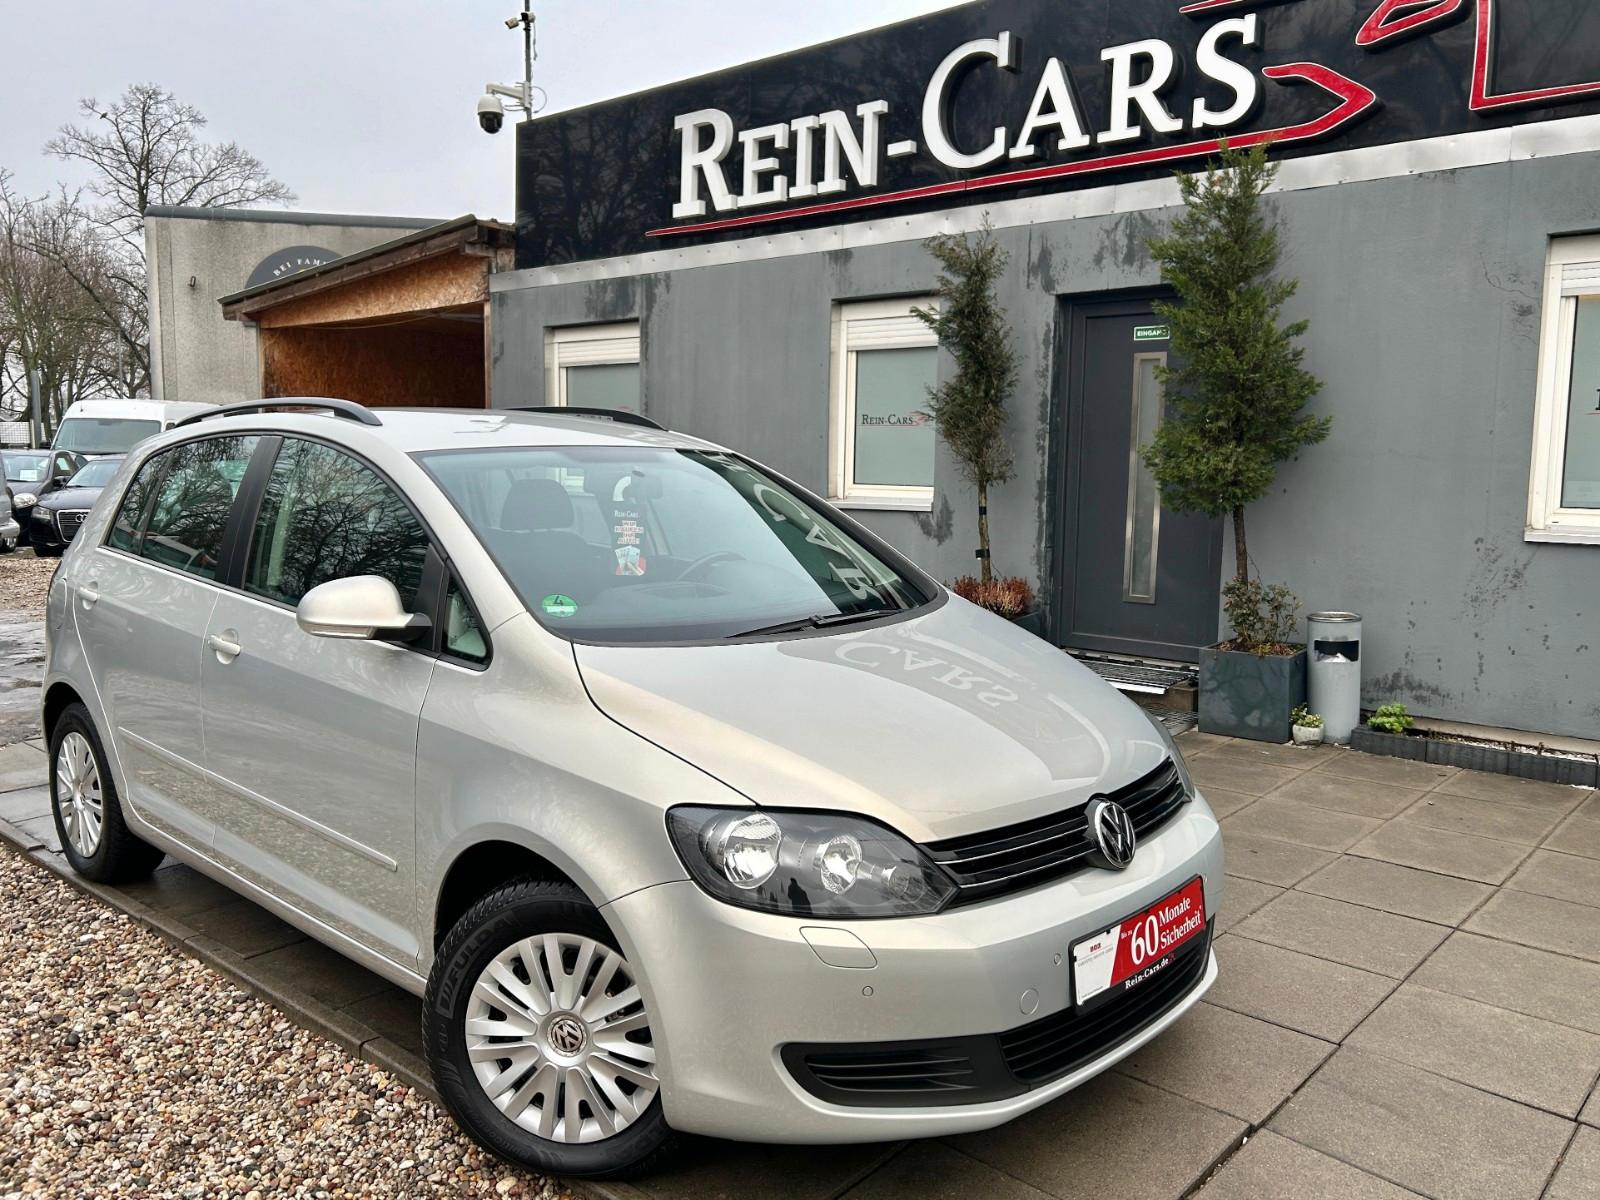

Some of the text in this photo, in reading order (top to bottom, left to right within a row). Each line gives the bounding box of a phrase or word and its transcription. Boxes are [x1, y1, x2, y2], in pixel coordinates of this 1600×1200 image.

[672, 13, 1260, 219] REIN-CARS
[273, 262, 292, 276] BEI
[861, 414, 914, 425] REIN-CARS
[1131, 915, 1159, 965] 60
[1159, 897, 1191, 926] Monate
[1125, 957, 1169, 990] Rein-Cars.de
